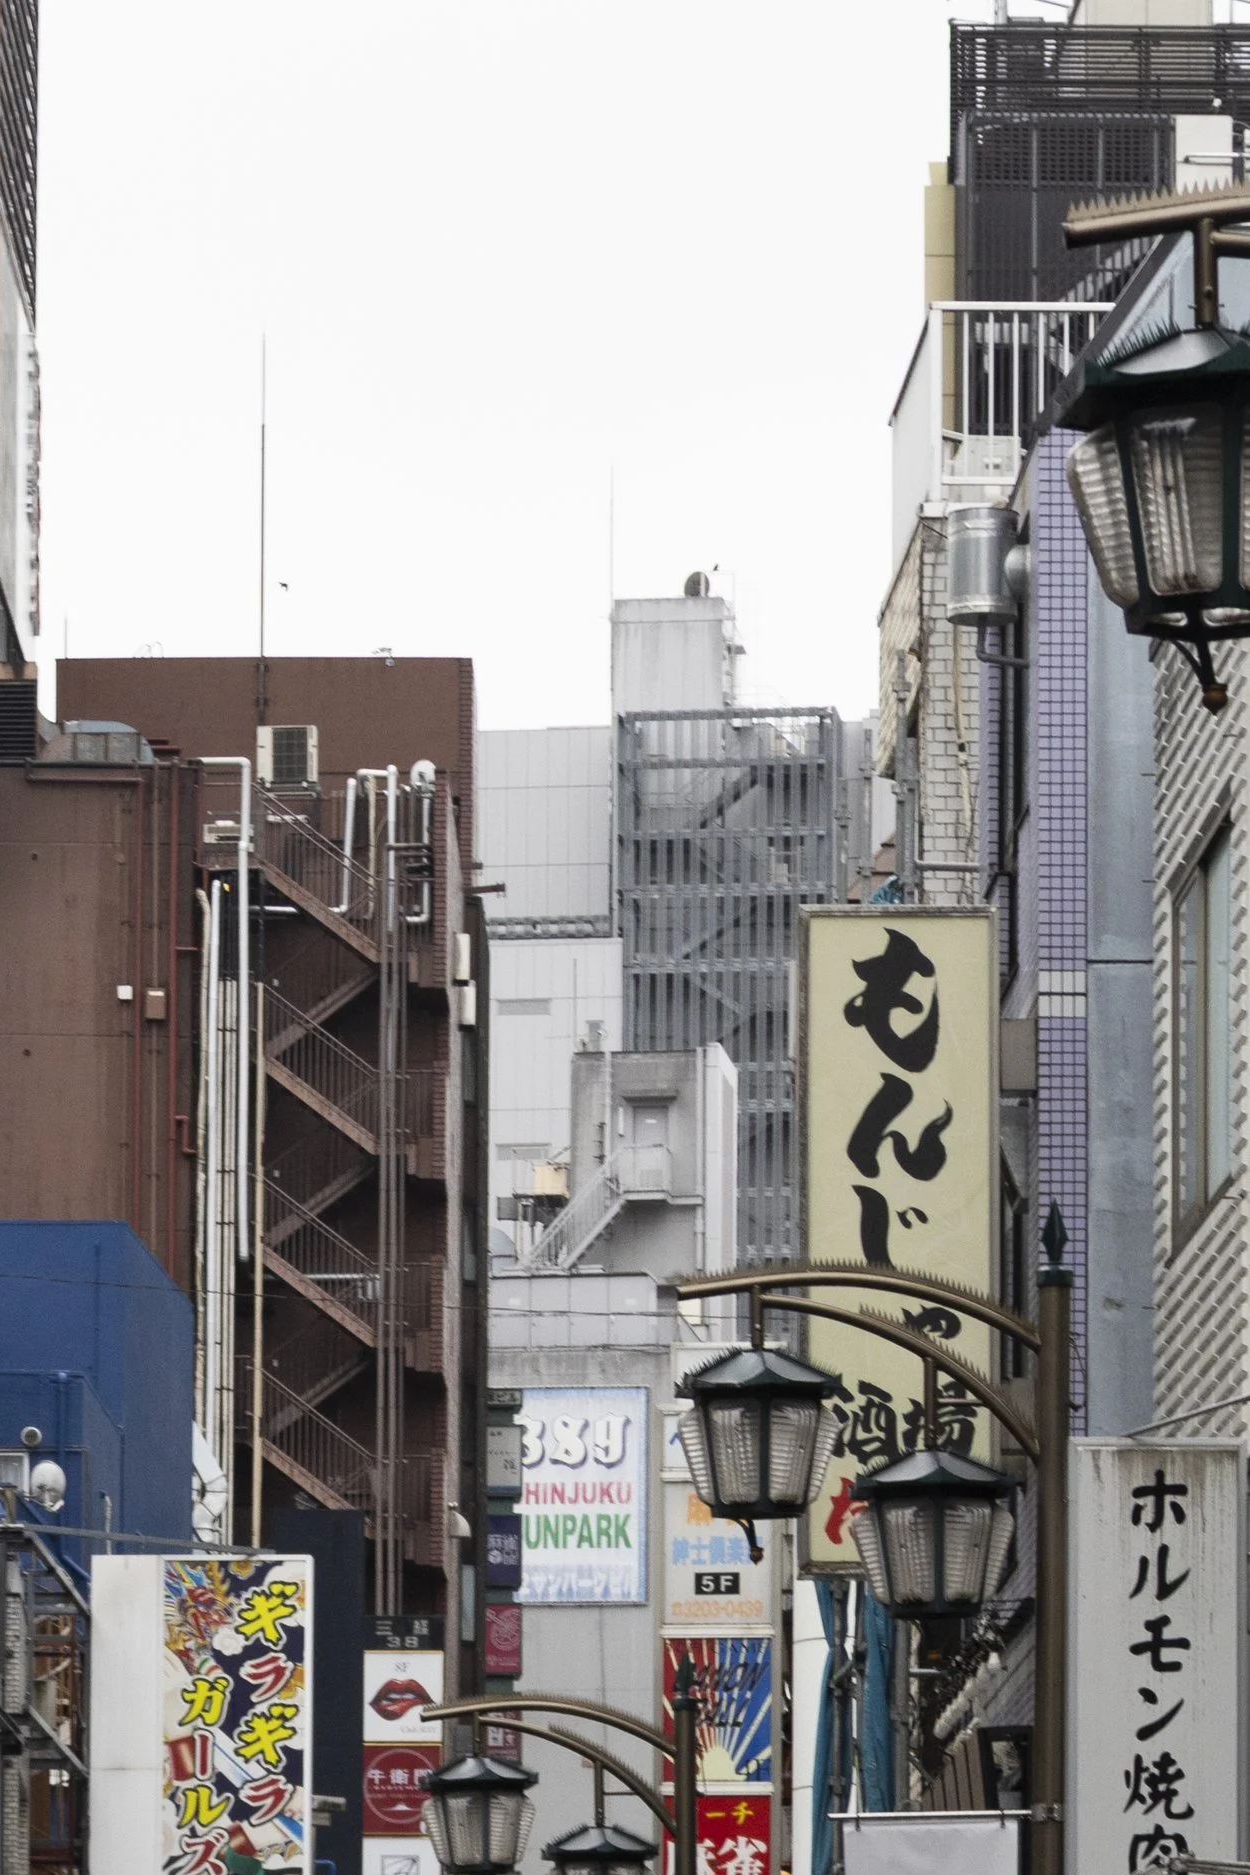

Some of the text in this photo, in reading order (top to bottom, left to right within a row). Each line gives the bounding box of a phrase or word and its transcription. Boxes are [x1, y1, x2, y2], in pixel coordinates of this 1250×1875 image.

[524, 1512, 632, 1550] UNPARK
[701, 1575, 735, 1593] 5F
[236, 1581, 299, 1827] ギラギラ
[705, 1802, 754, 1825] ーチ
